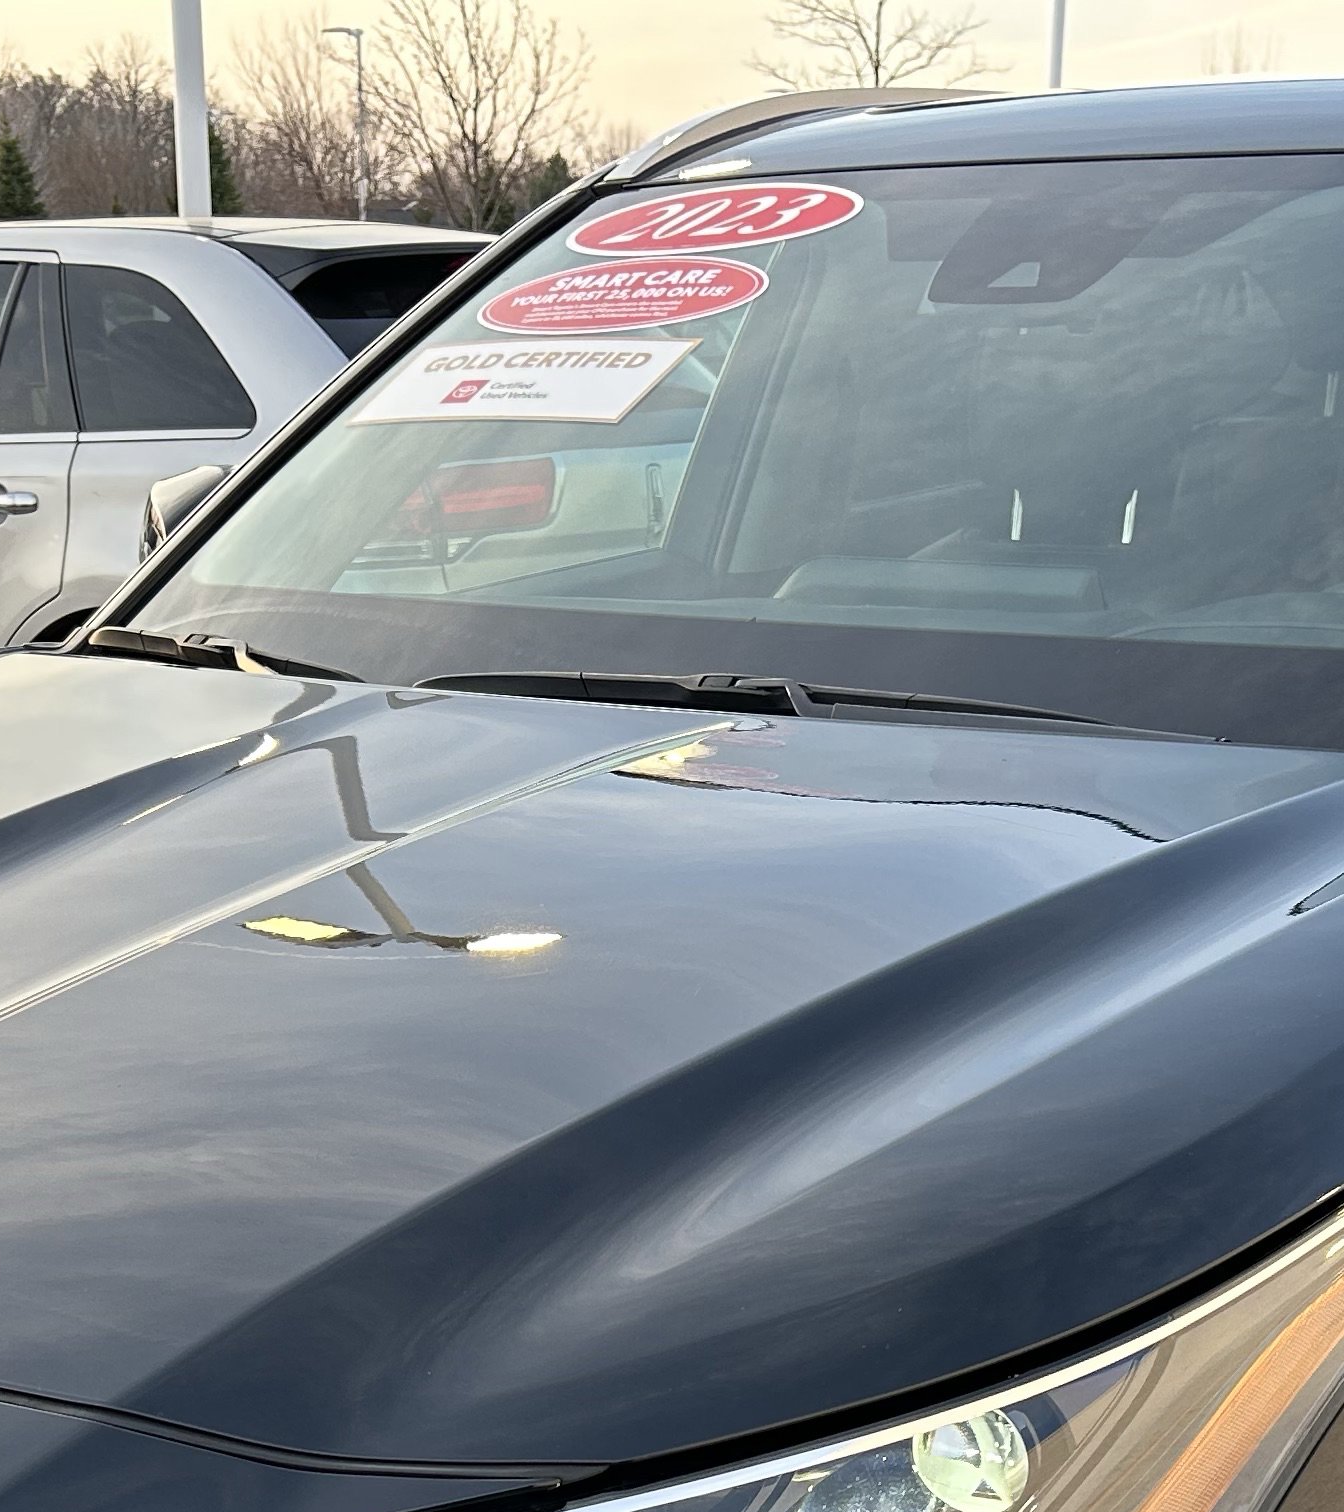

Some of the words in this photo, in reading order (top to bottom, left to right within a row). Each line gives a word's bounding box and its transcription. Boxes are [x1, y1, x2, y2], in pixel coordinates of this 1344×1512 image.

[598, 193, 828, 245] 2023
[549, 273, 645, 292] SMART
[645, 269, 722, 285] CARE
[511, 294, 559, 307] YOUR
[558, 290, 605, 304] FIRST
[607, 288, 667, 302] 25,000
[667, 286, 698, 299] ON
[699, 286, 733, 297] US!
[424, 355, 503, 373] GOLD
[504, 352, 652, 369] CERTIFIED
[479, 391, 506, 400] Used
[506, 391, 549, 400] Vehicles
[489, 381, 536, 391] Certified
